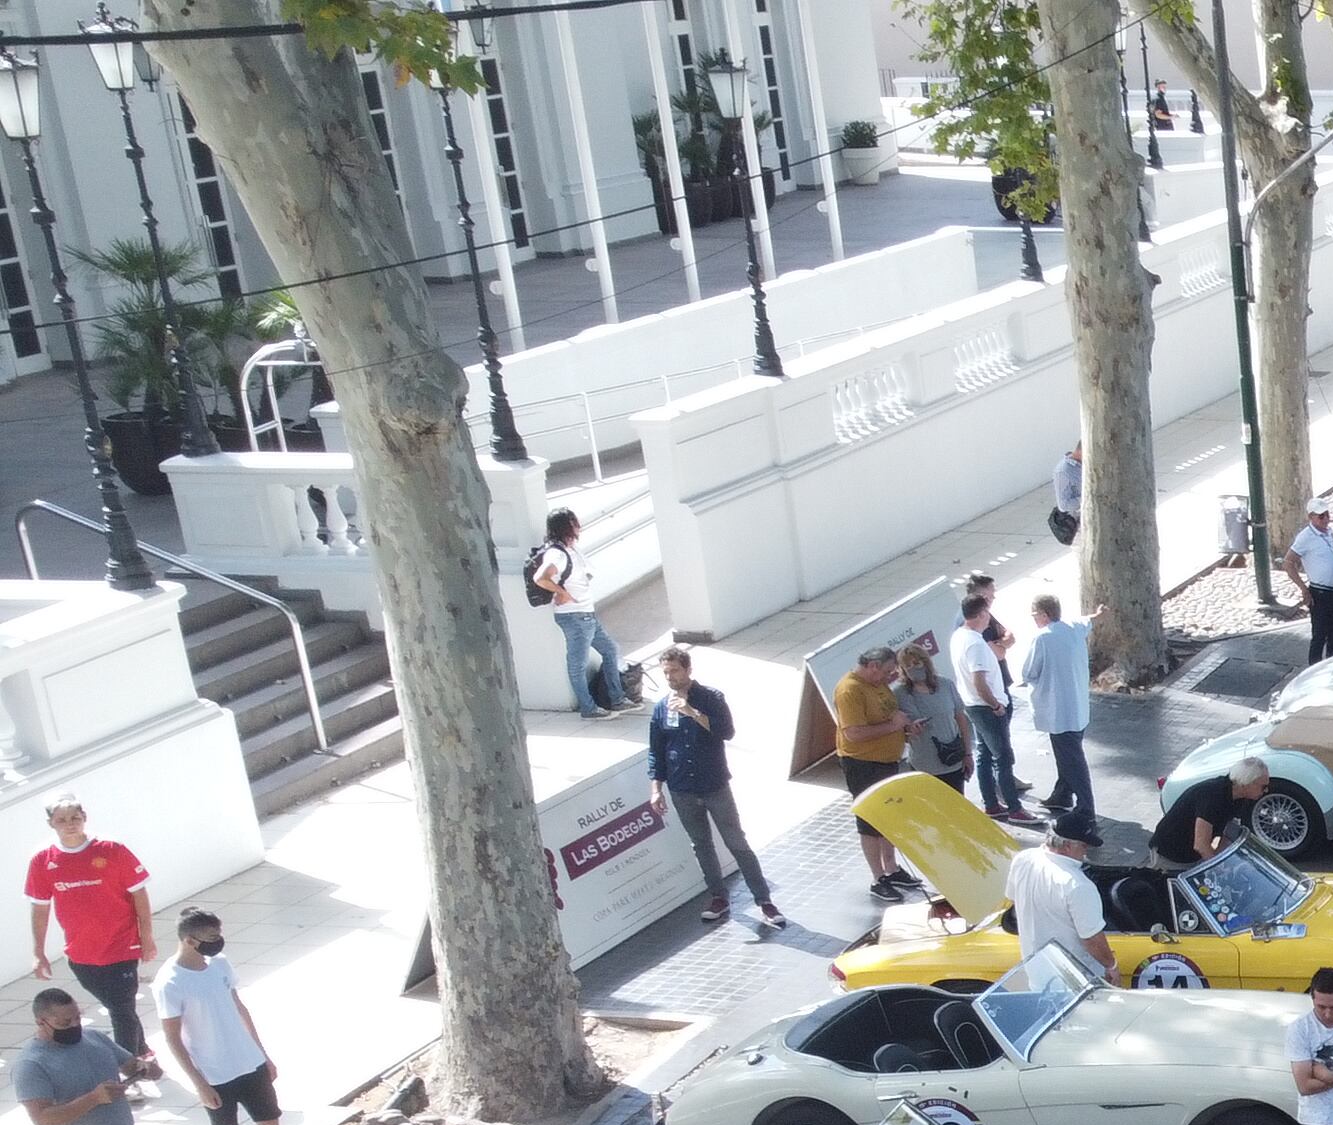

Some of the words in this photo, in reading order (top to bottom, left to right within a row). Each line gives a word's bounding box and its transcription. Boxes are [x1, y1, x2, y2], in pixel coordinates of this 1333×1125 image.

[577, 805, 609, 829] RALLY
[610, 797, 626, 813] DE
[570, 844, 599, 866] LAS
[596, 811, 655, 853] BODEGAS
